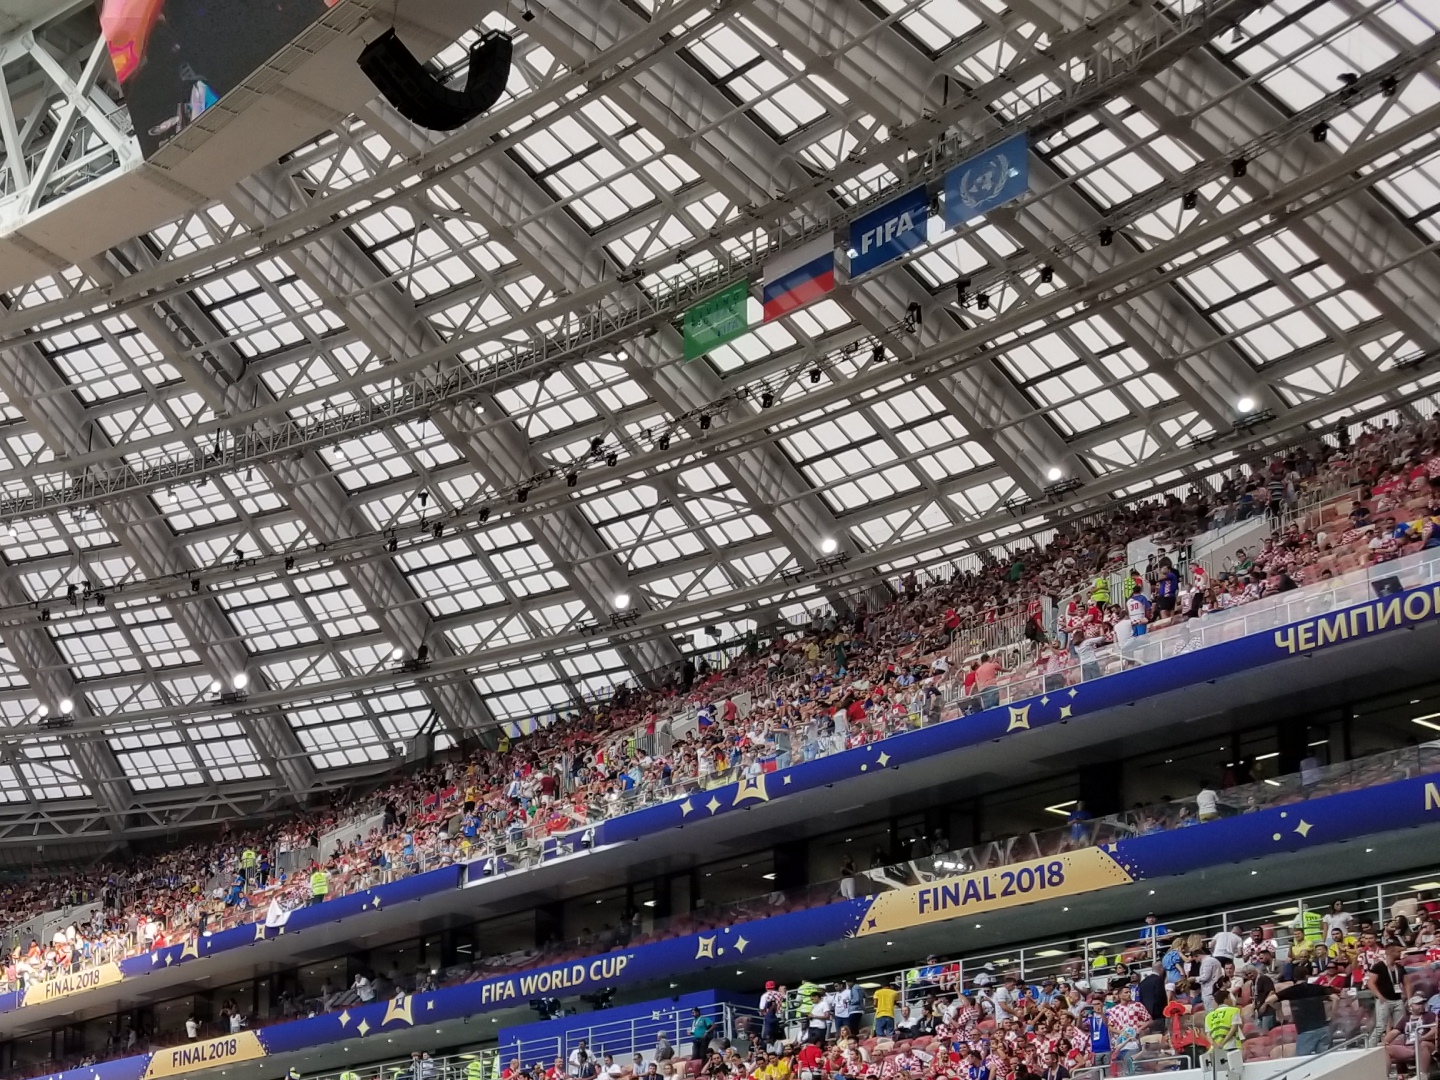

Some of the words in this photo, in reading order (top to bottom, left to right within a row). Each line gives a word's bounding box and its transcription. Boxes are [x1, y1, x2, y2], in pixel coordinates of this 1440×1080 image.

[861, 210, 915, 255] FIFA
[1275, 587, 1440, 654] ЧЕМПИО
[919, 876, 996, 915] FINAL
[1001, 861, 1065, 898] 2018
[45, 978, 75, 998] FINAL
[77, 969, 100, 990] 2018
[481, 980, 515, 1004] FIFA
[520, 965, 585, 996] WORLD
[172, 1045, 206, 1067] FINAL
[209, 1039, 237, 1059] 2018
